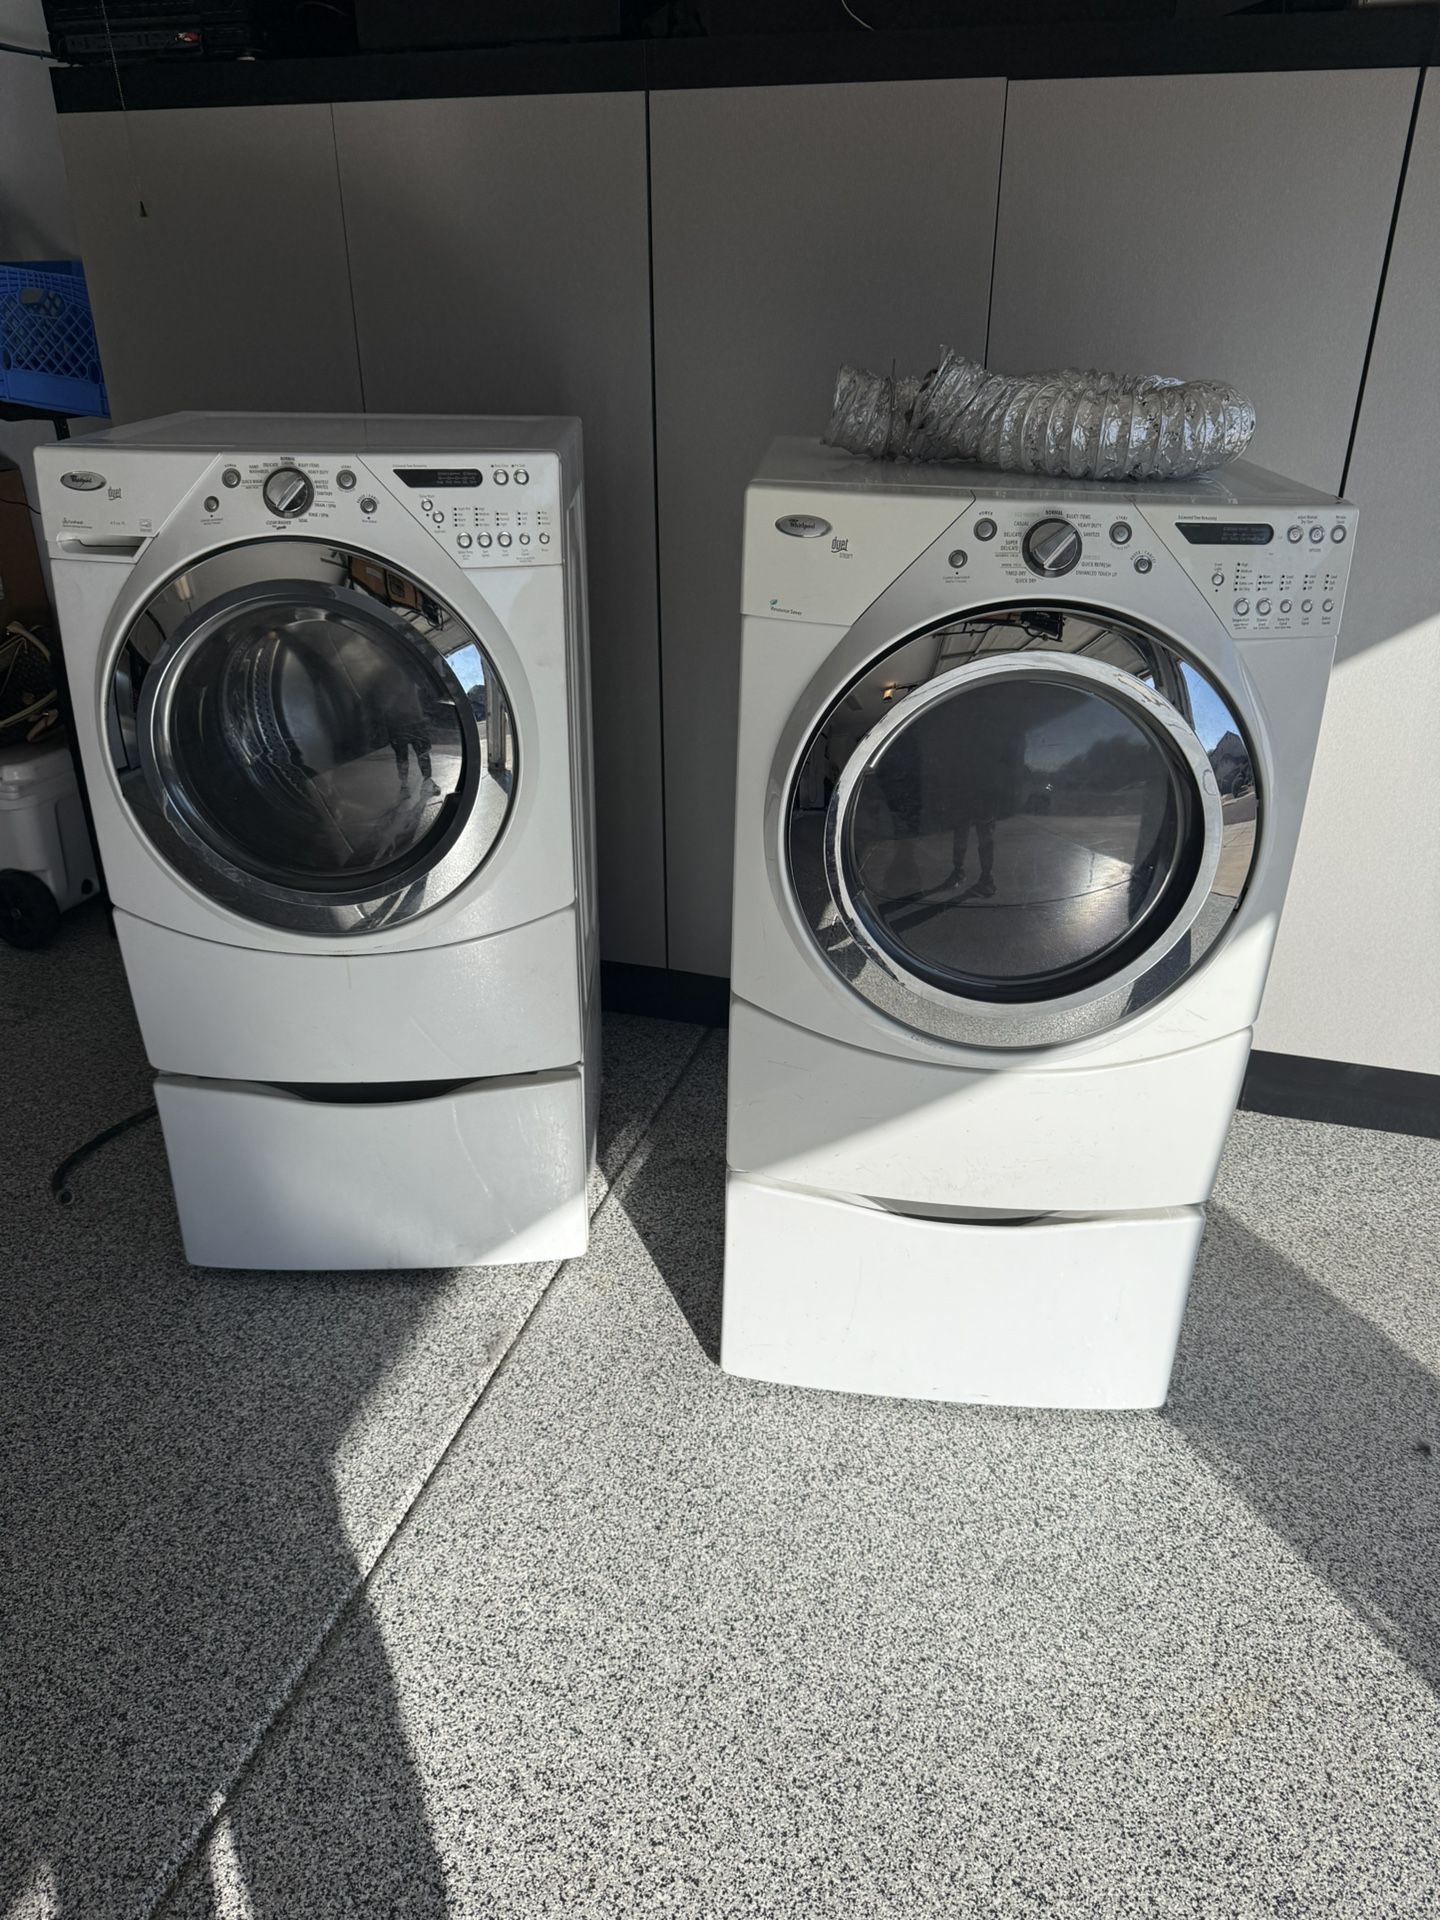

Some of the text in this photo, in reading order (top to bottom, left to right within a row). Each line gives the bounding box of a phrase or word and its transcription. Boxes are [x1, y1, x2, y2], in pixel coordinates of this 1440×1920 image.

[789, 518, 816, 530] Whirlpool
[831, 536, 849, 553] duet
[770, 606, 790, 614] Resource
